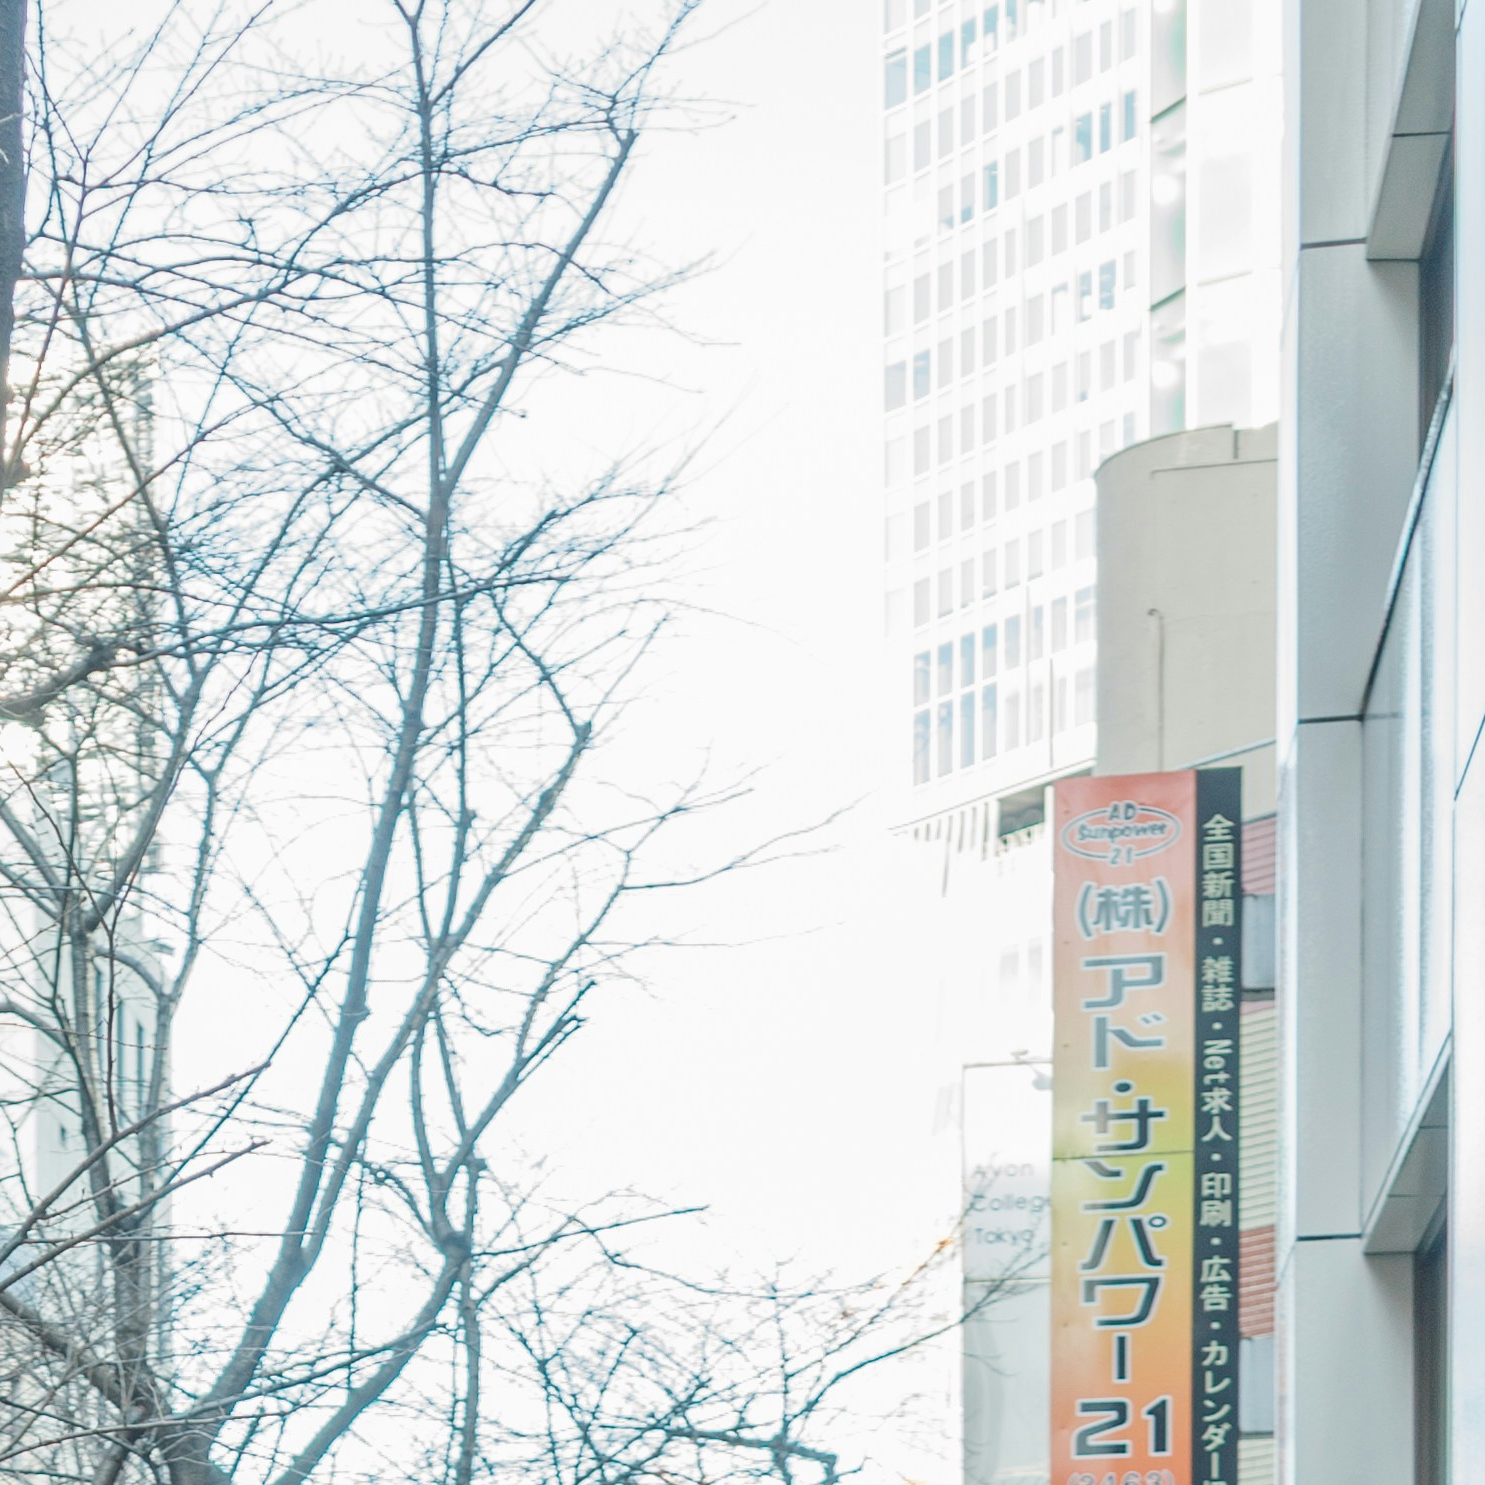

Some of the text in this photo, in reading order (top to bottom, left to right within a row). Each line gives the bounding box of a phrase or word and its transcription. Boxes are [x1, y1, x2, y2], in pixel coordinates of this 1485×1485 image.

[1108, 802, 1137, 821] AD
[1077, 823, 1168, 843] Sunpower
[1109, 847, 1133, 865] 21
